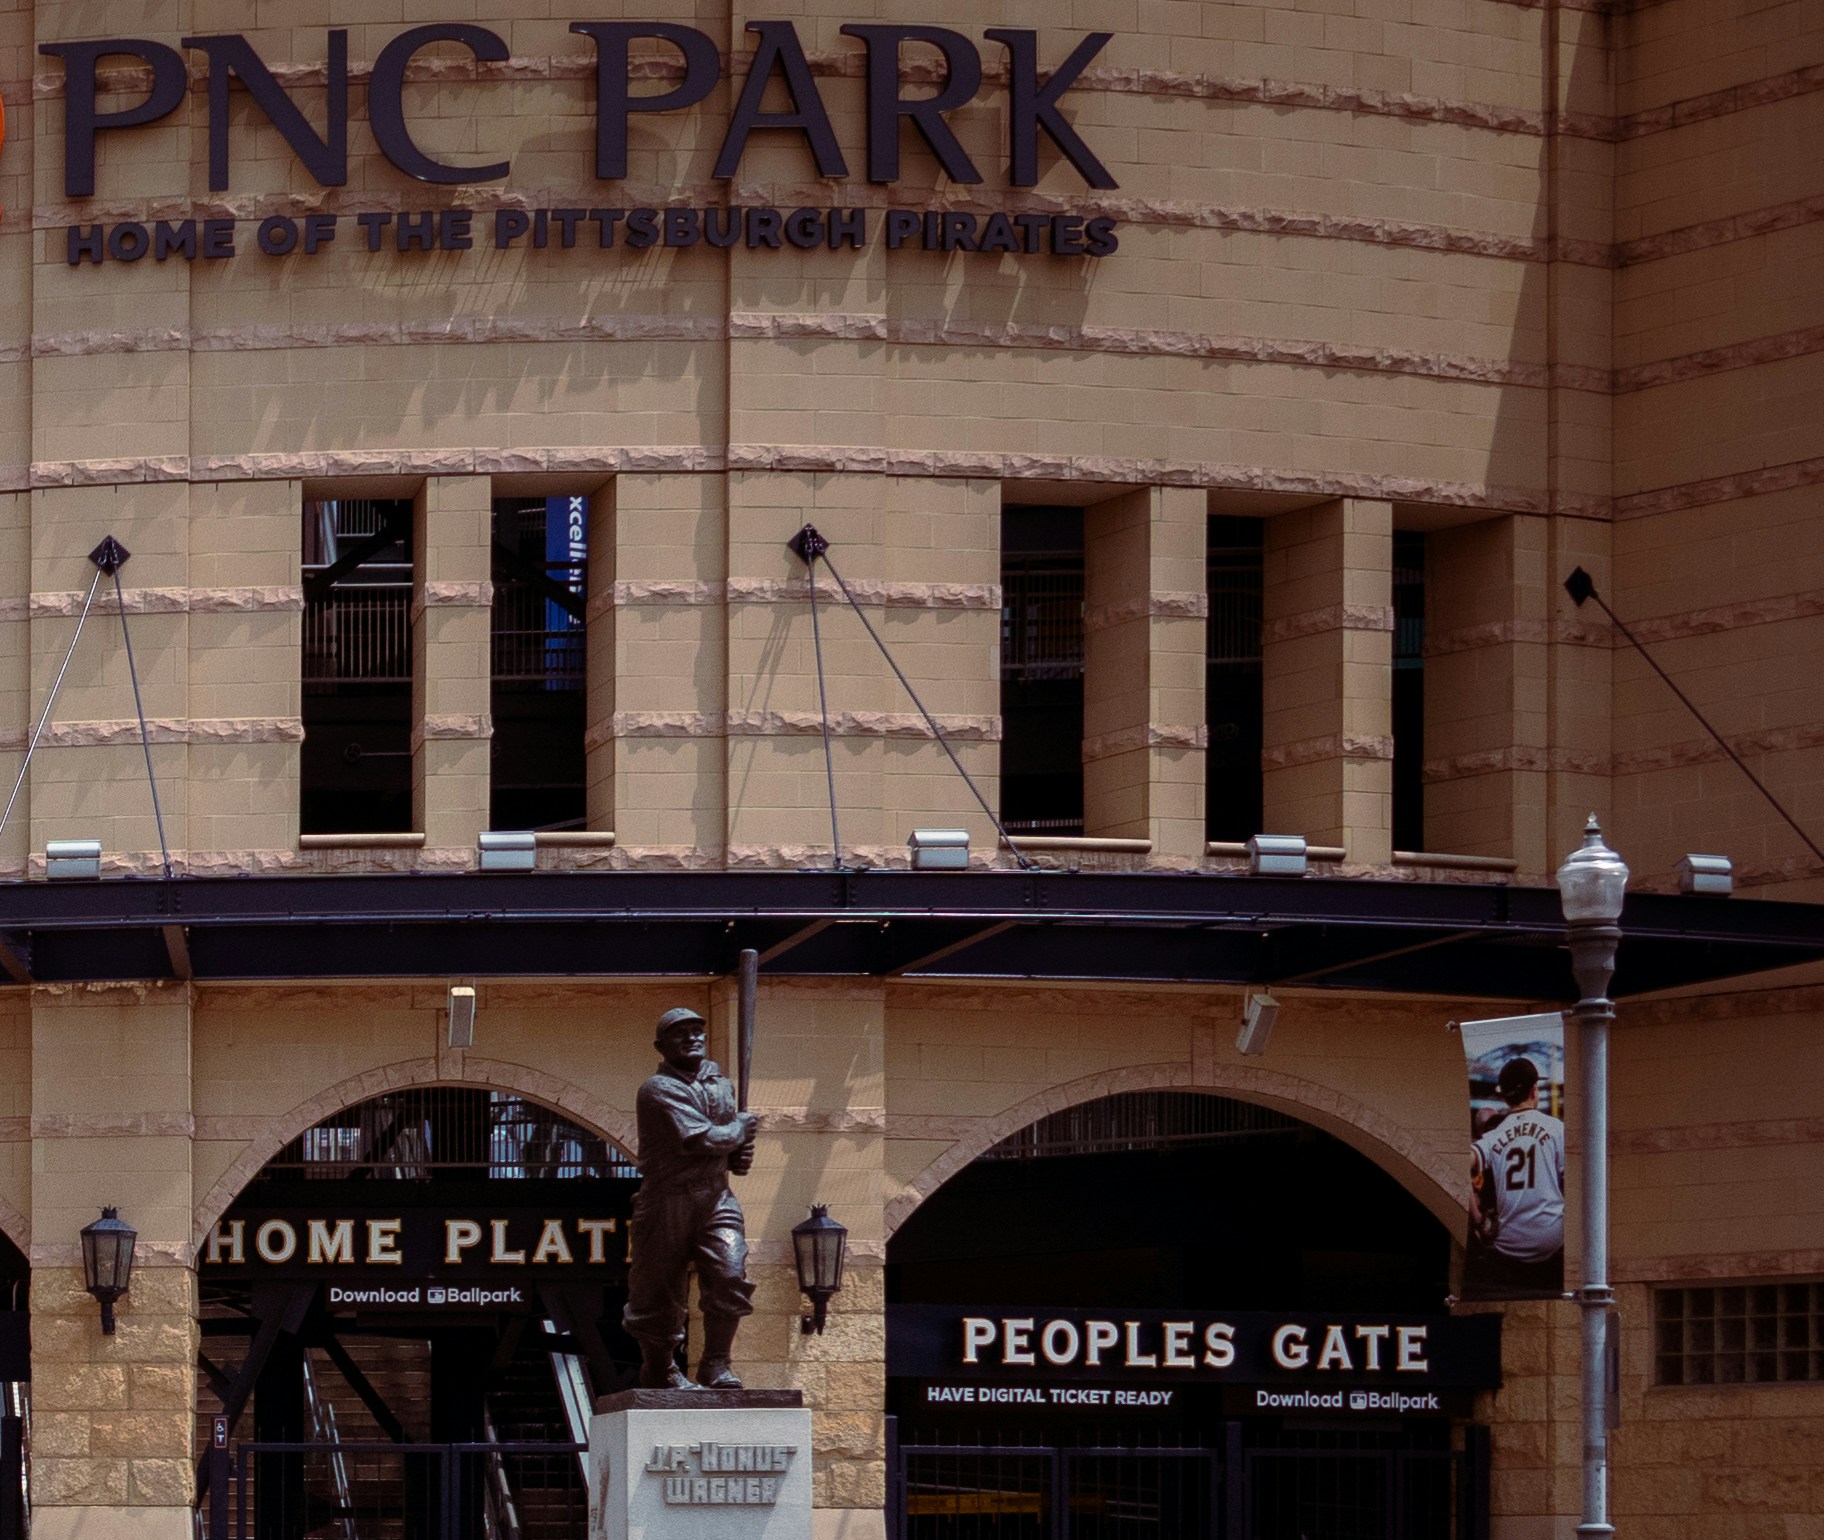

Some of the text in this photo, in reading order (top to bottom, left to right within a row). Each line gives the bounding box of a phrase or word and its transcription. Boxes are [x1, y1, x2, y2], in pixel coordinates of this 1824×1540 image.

[38, 20, 1120, 197] PNC PARK
[67, 207, 1120, 266] HOME OF THE PITTSBURGH PIRATES
[1505, 1143, 1536, 1192] 21
[205, 1218, 633, 1265] HOME PLAT
[330, 1287, 522, 1306] Download Ballpark
[962, 1317, 1429, 1372] PEOPLES GATE
[927, 1386, 1173, 1405] HAVE DIGITAL TICKET READY
[1256, 1390, 1439, 1413] Download Ballpark
[664, 1477, 777, 1505] WAGNER
